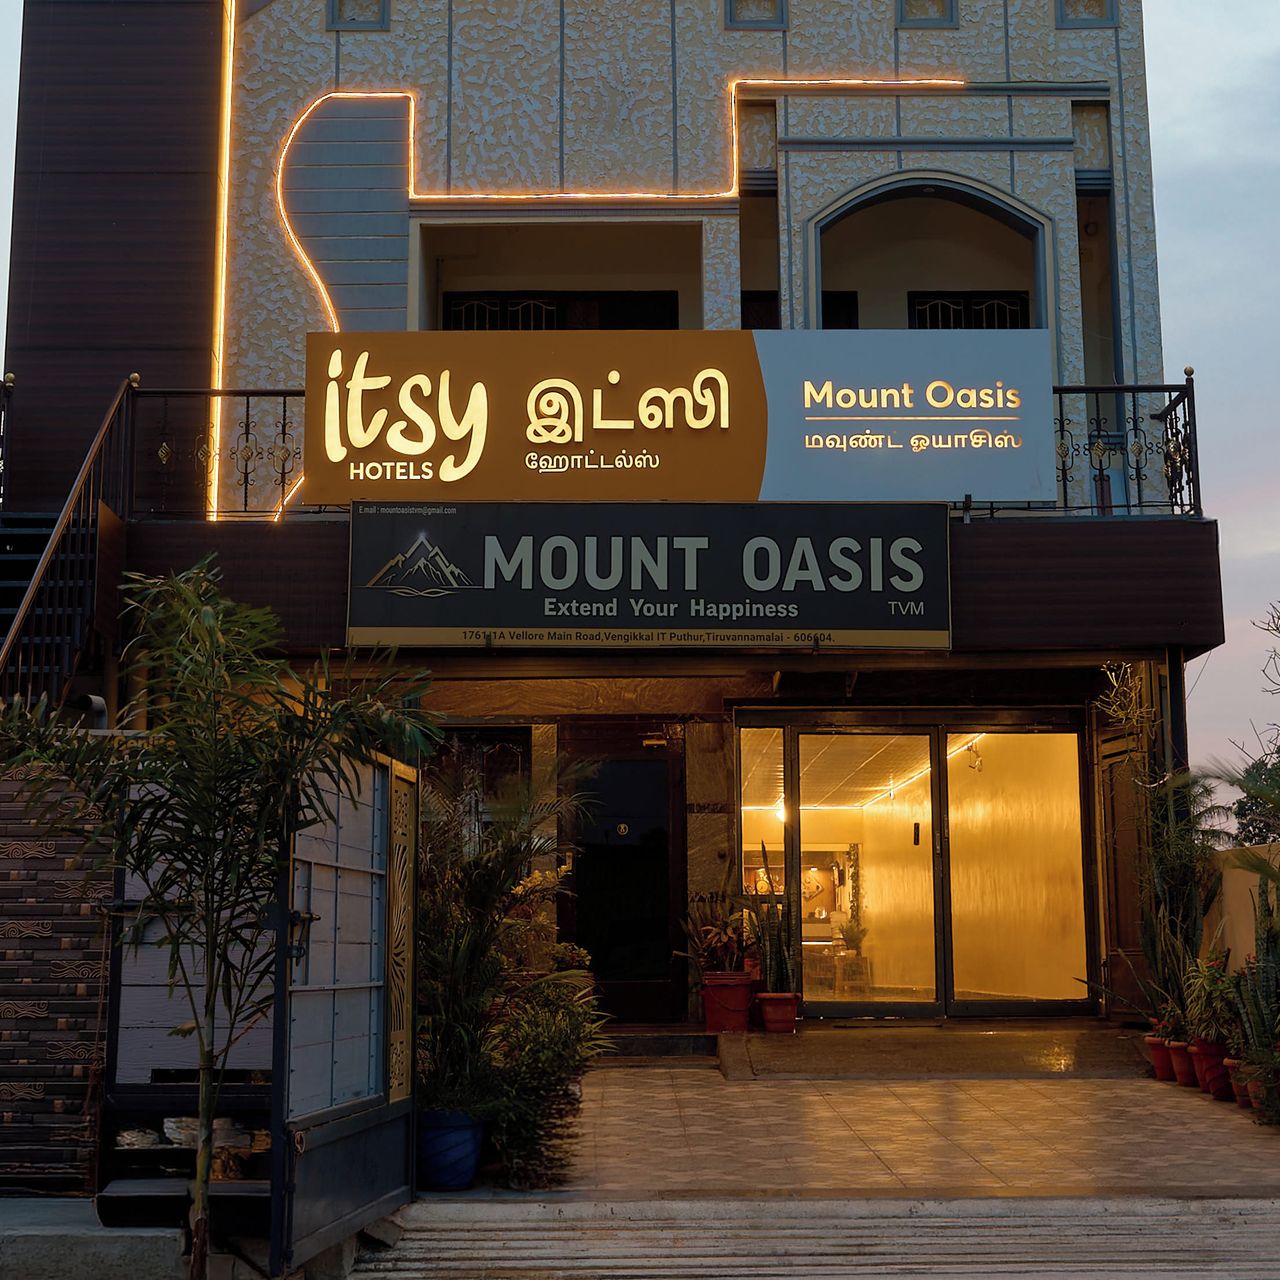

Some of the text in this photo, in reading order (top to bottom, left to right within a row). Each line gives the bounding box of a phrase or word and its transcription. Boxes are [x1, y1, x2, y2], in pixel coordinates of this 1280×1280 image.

[525, 368, 730, 444] இட்ஸி
[803, 380, 1022, 410] Mount Oasis
[324, 349, 489, 482] itsy
[349, 461, 434, 480] HOTELS
[525, 449, 660, 474] ஹோட்டல்ஸ்
[483, 535, 925, 593] MOUNT OASIS
[543, 597, 799, 620] Extend Your Happiness
[887, 600, 925, 616] TVM
[508, 631, 545, 641] Vellore
[547, 631, 573, 641] Main
